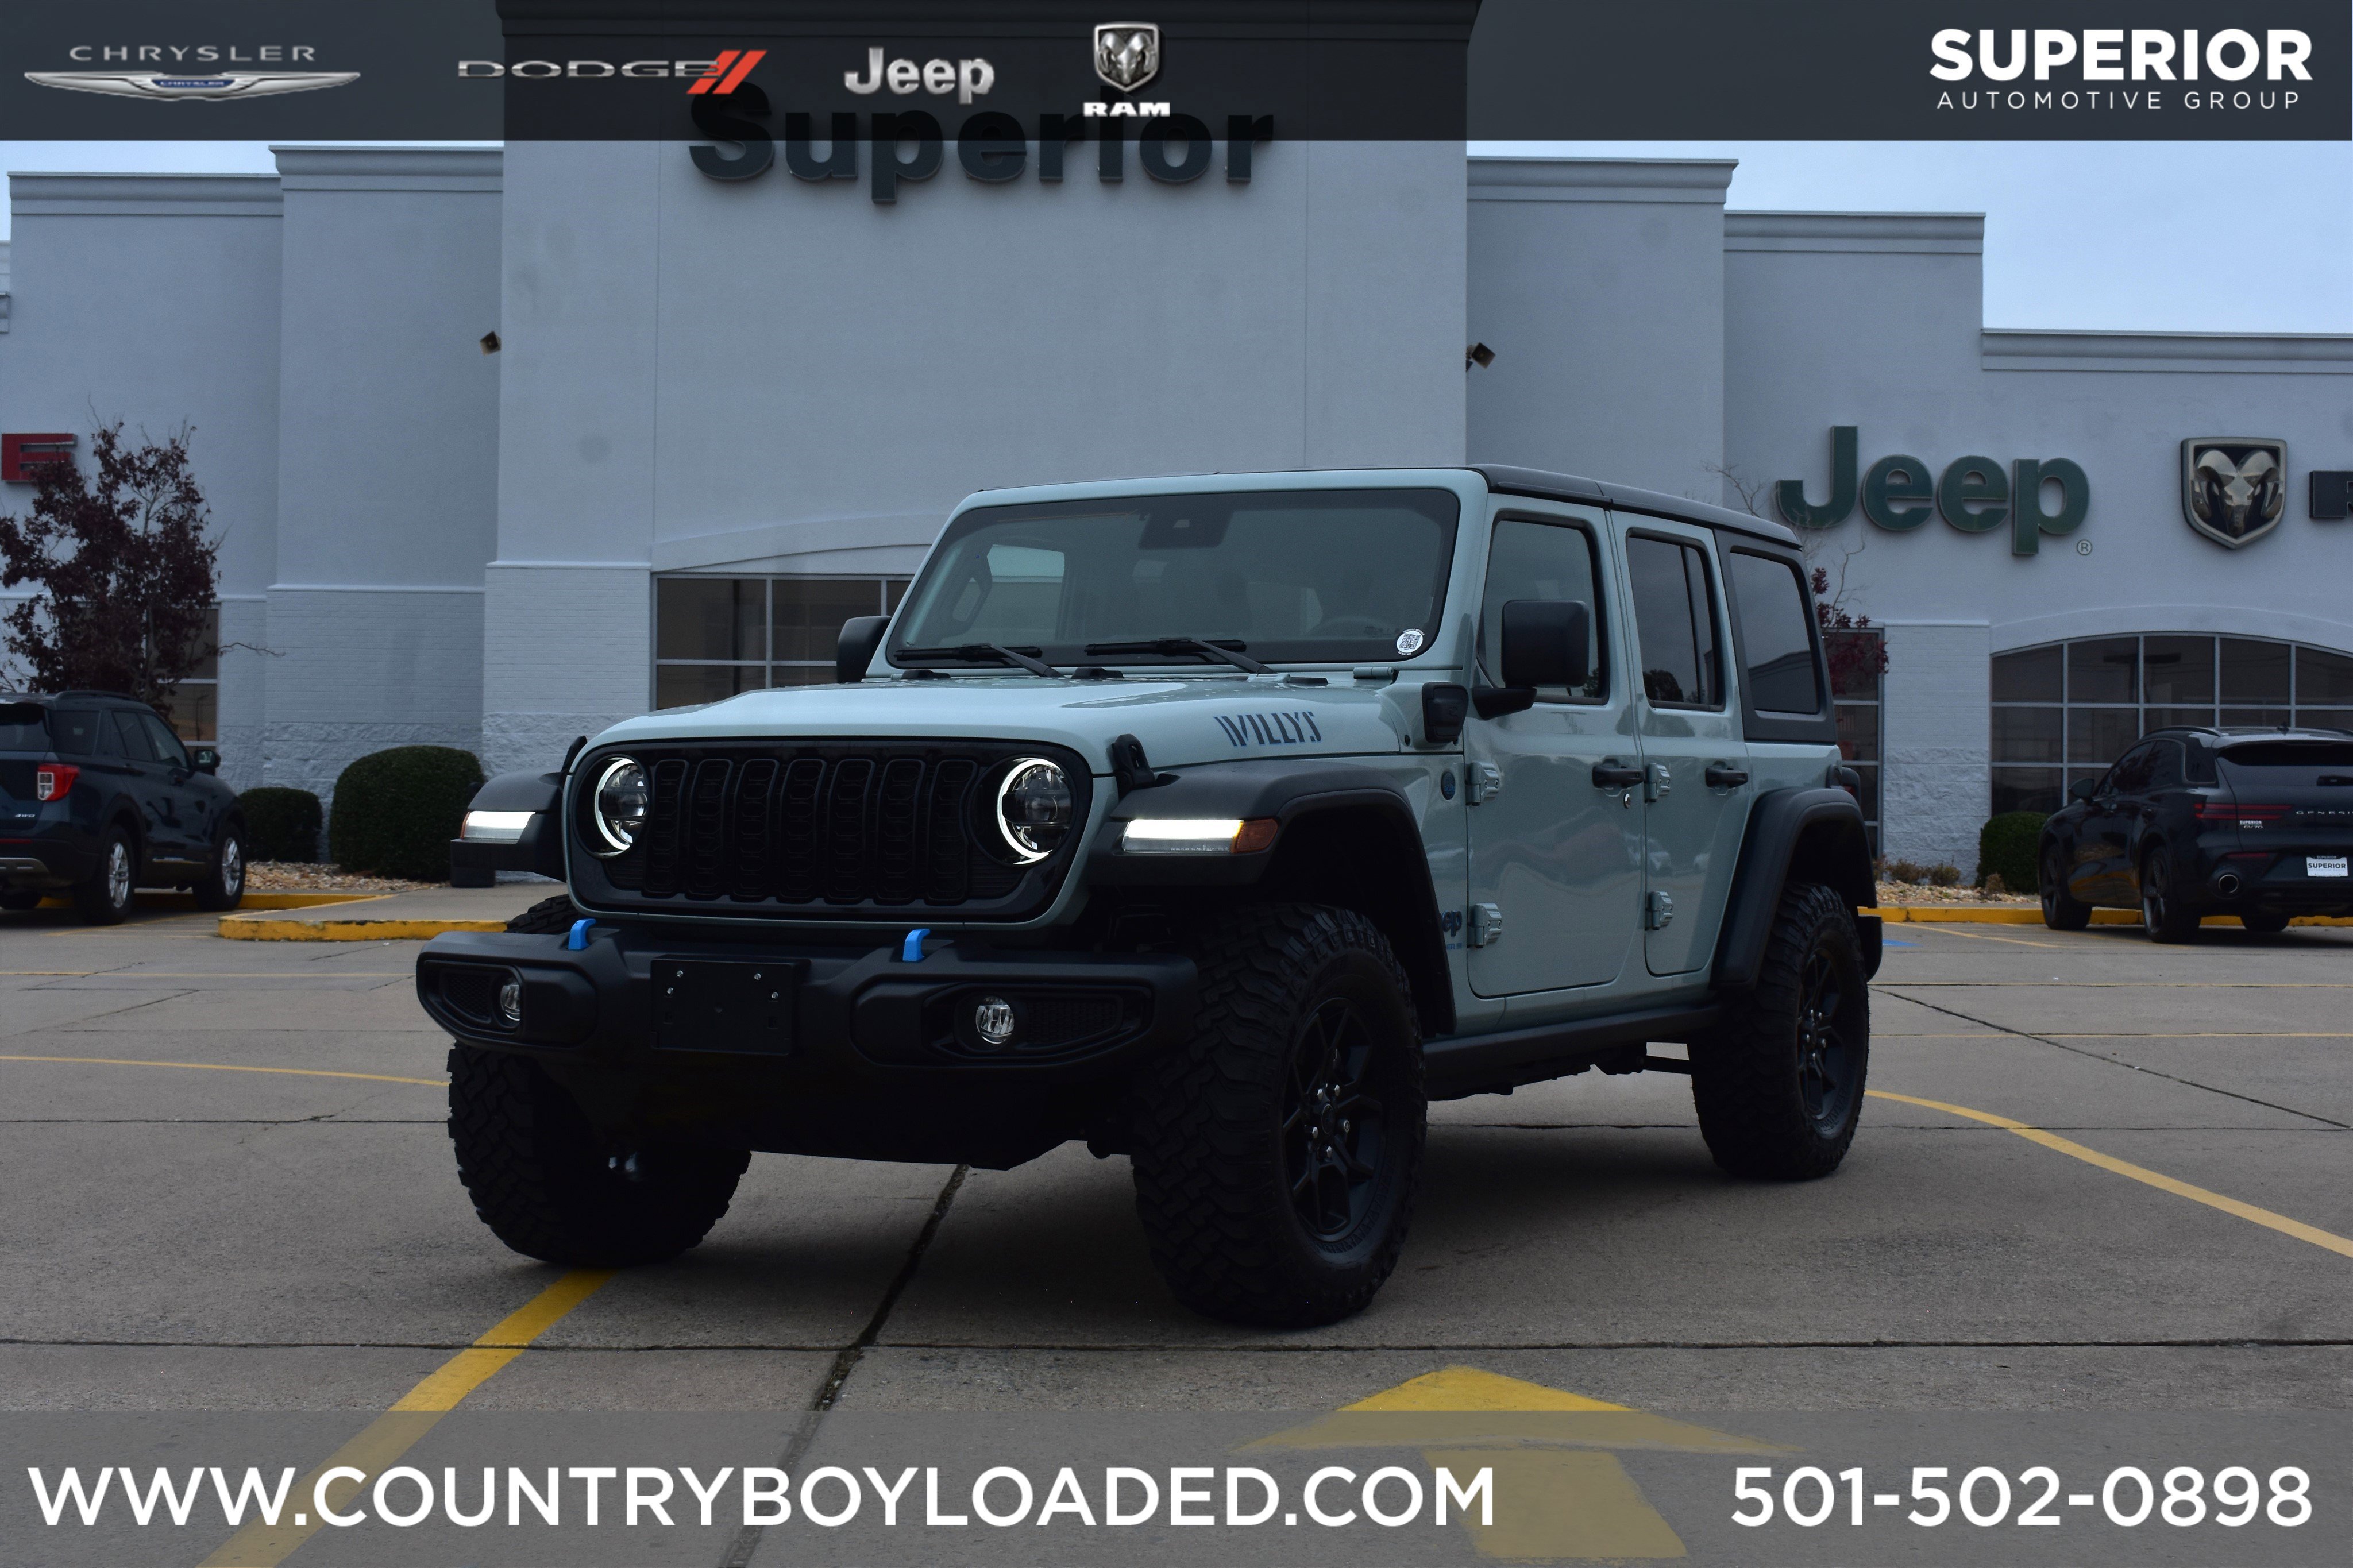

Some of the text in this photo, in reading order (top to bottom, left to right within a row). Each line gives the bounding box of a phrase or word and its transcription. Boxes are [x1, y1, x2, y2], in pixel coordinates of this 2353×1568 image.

[689, 80, 1275, 204] Superior
[1776, 425, 2090, 555] Jeep
[1214, 711, 1322, 746] WILLYS
